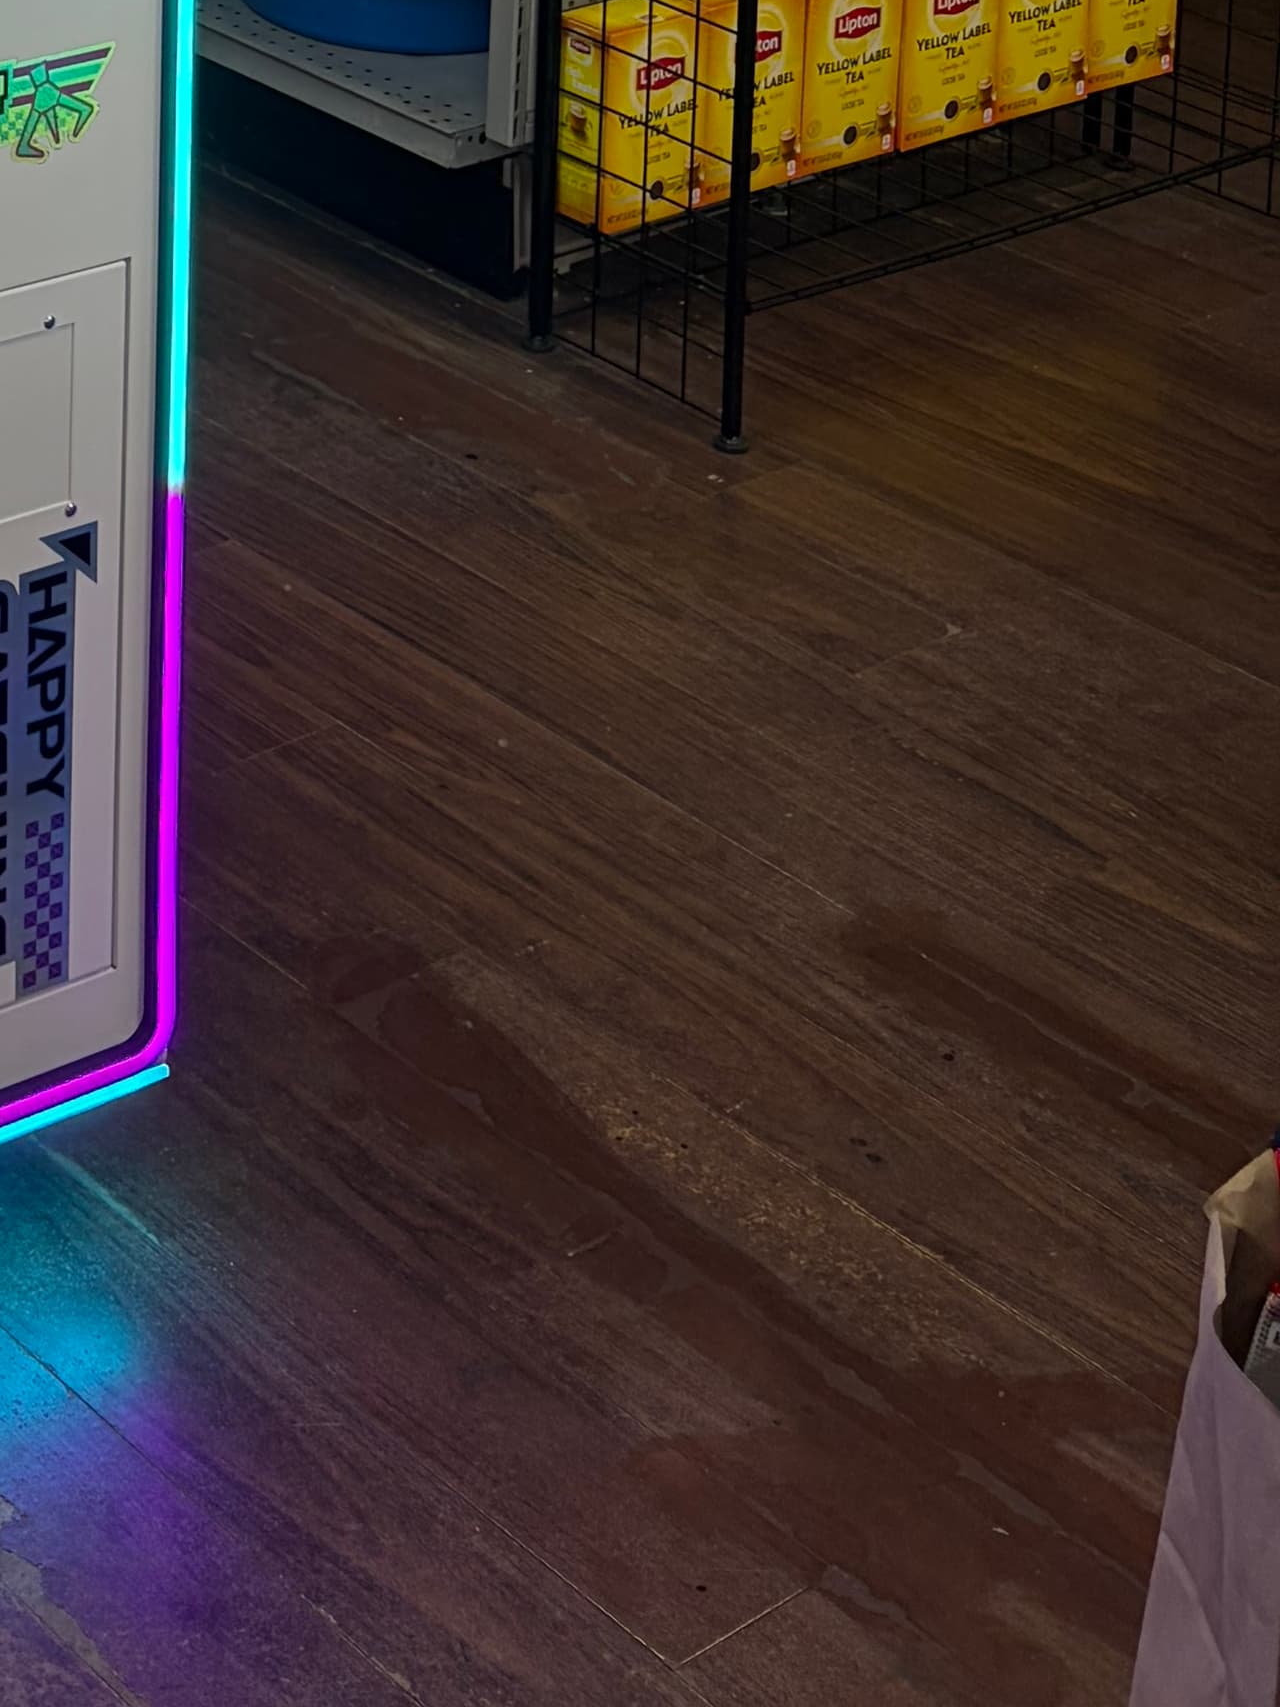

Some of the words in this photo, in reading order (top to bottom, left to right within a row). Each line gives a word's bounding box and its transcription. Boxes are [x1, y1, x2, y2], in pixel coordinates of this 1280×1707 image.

[838, 11, 878, 34] Lipton
[1008, 3, 1051, 25] YELLOW
[1037, 18, 1056, 33] TEA
[756, 36, 779, 55] ton
[916, 31, 960, 52] YELLOW
[962, 22, 992, 40] LABEL
[816, 55, 860, 76] YELLOW
[862, 47, 893, 64] LABEL
[944, 46, 965, 61] TEA
[640, 62, 682, 86] Lpton
[763, 71, 795, 89] LABEL
[845, 71, 865, 85] TEA
[753, 96, 766, 109] EA
[649, 122, 670, 138] TEA
[27, 570, 68, 799] HAPPY
